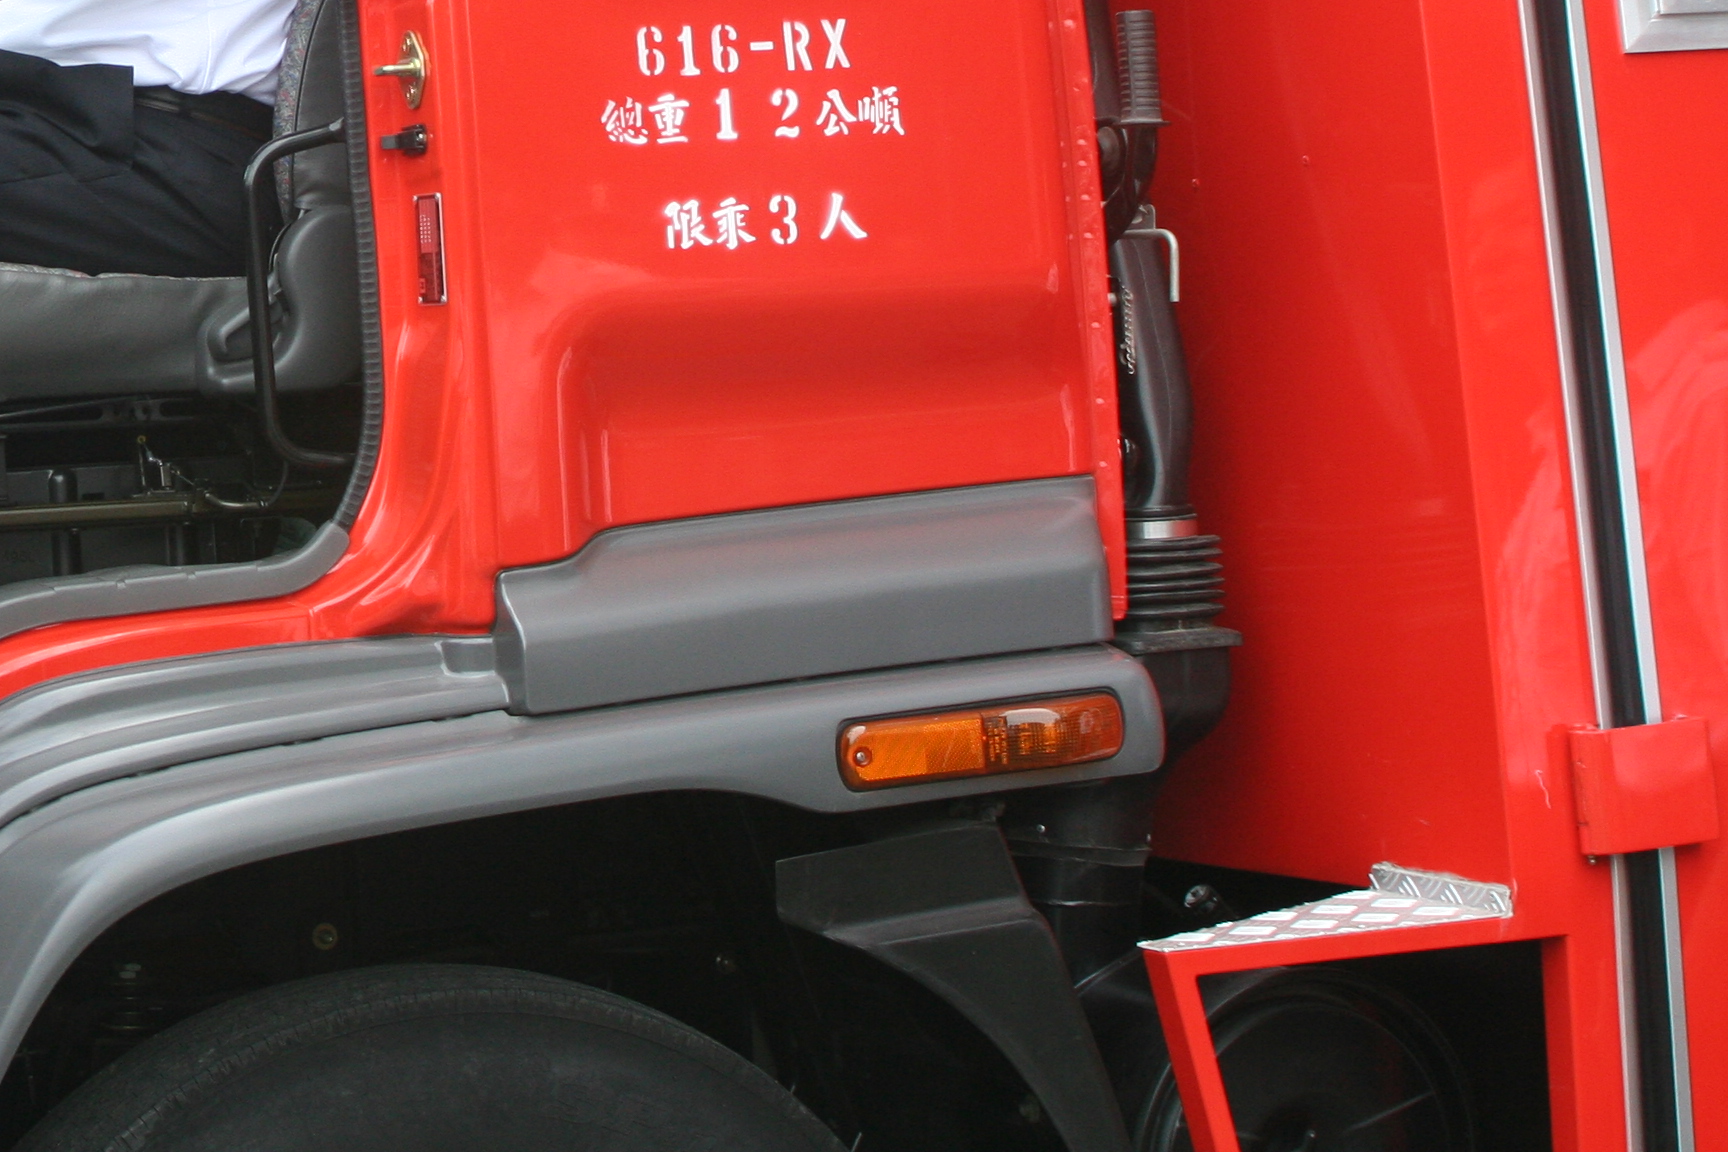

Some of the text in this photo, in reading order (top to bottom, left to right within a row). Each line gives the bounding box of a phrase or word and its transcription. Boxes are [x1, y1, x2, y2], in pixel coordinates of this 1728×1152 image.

[636, 18, 851, 77] 616-RX
[663, 192, 869, 250] 限乘3人
